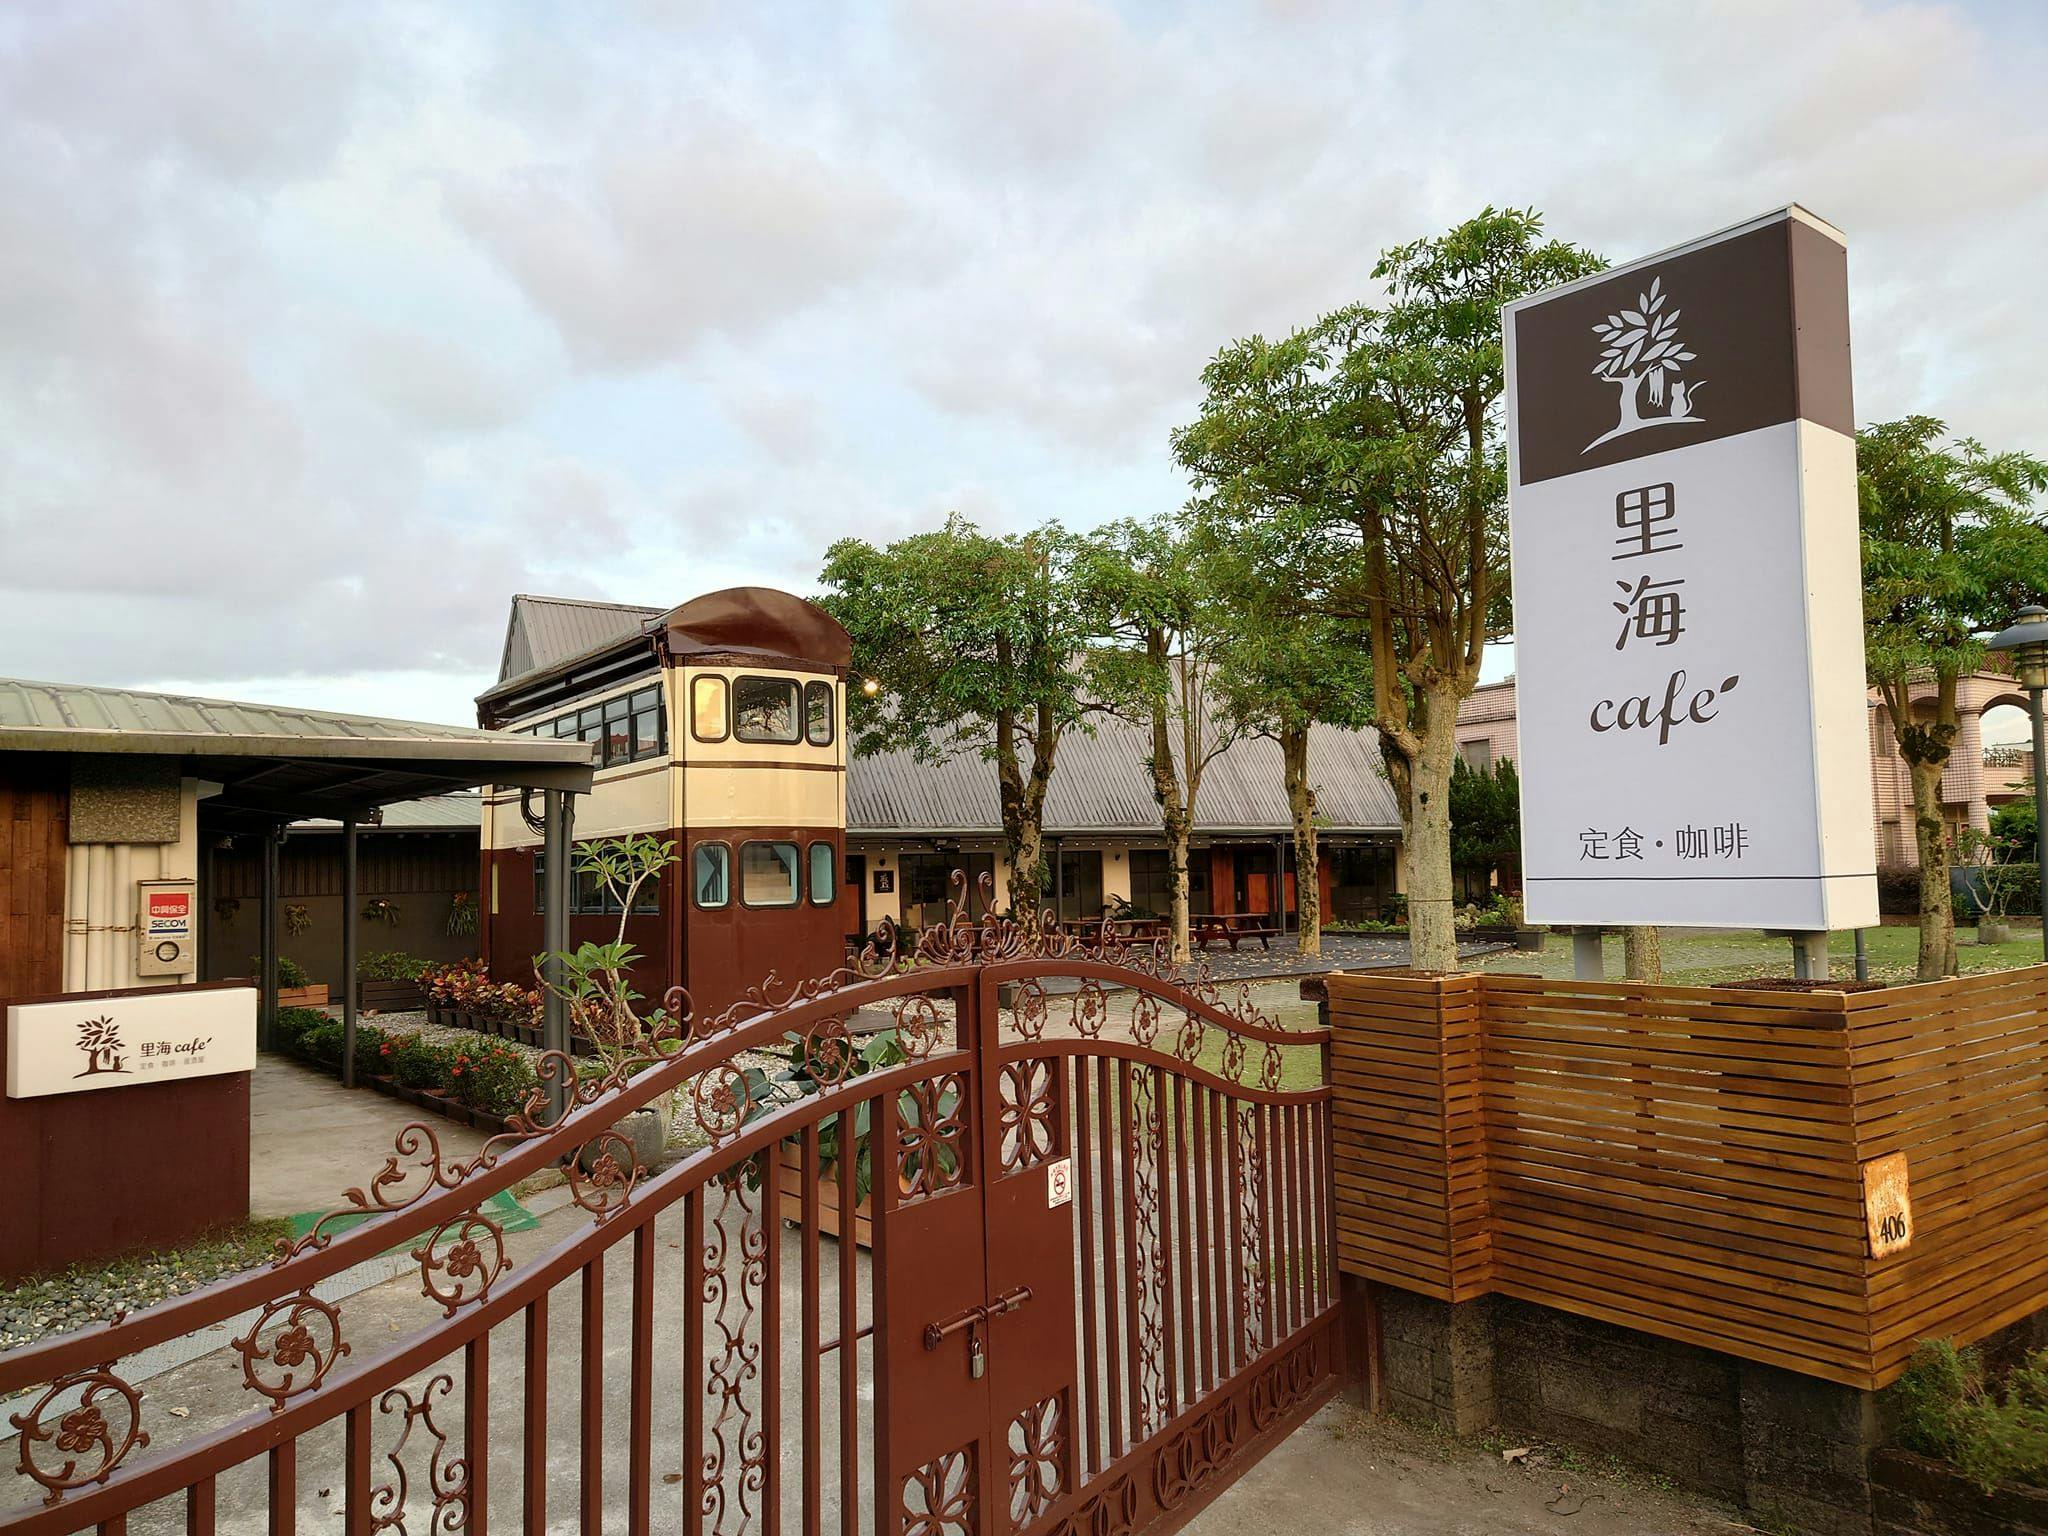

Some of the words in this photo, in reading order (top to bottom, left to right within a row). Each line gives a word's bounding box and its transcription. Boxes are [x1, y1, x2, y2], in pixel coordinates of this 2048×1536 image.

[1611, 482, 1687, 651] 里海
[151, 919, 187, 928] SECOM
[140, 1041, 172, 1057] 里海
[1880, 1212, 1906, 1243] 406
